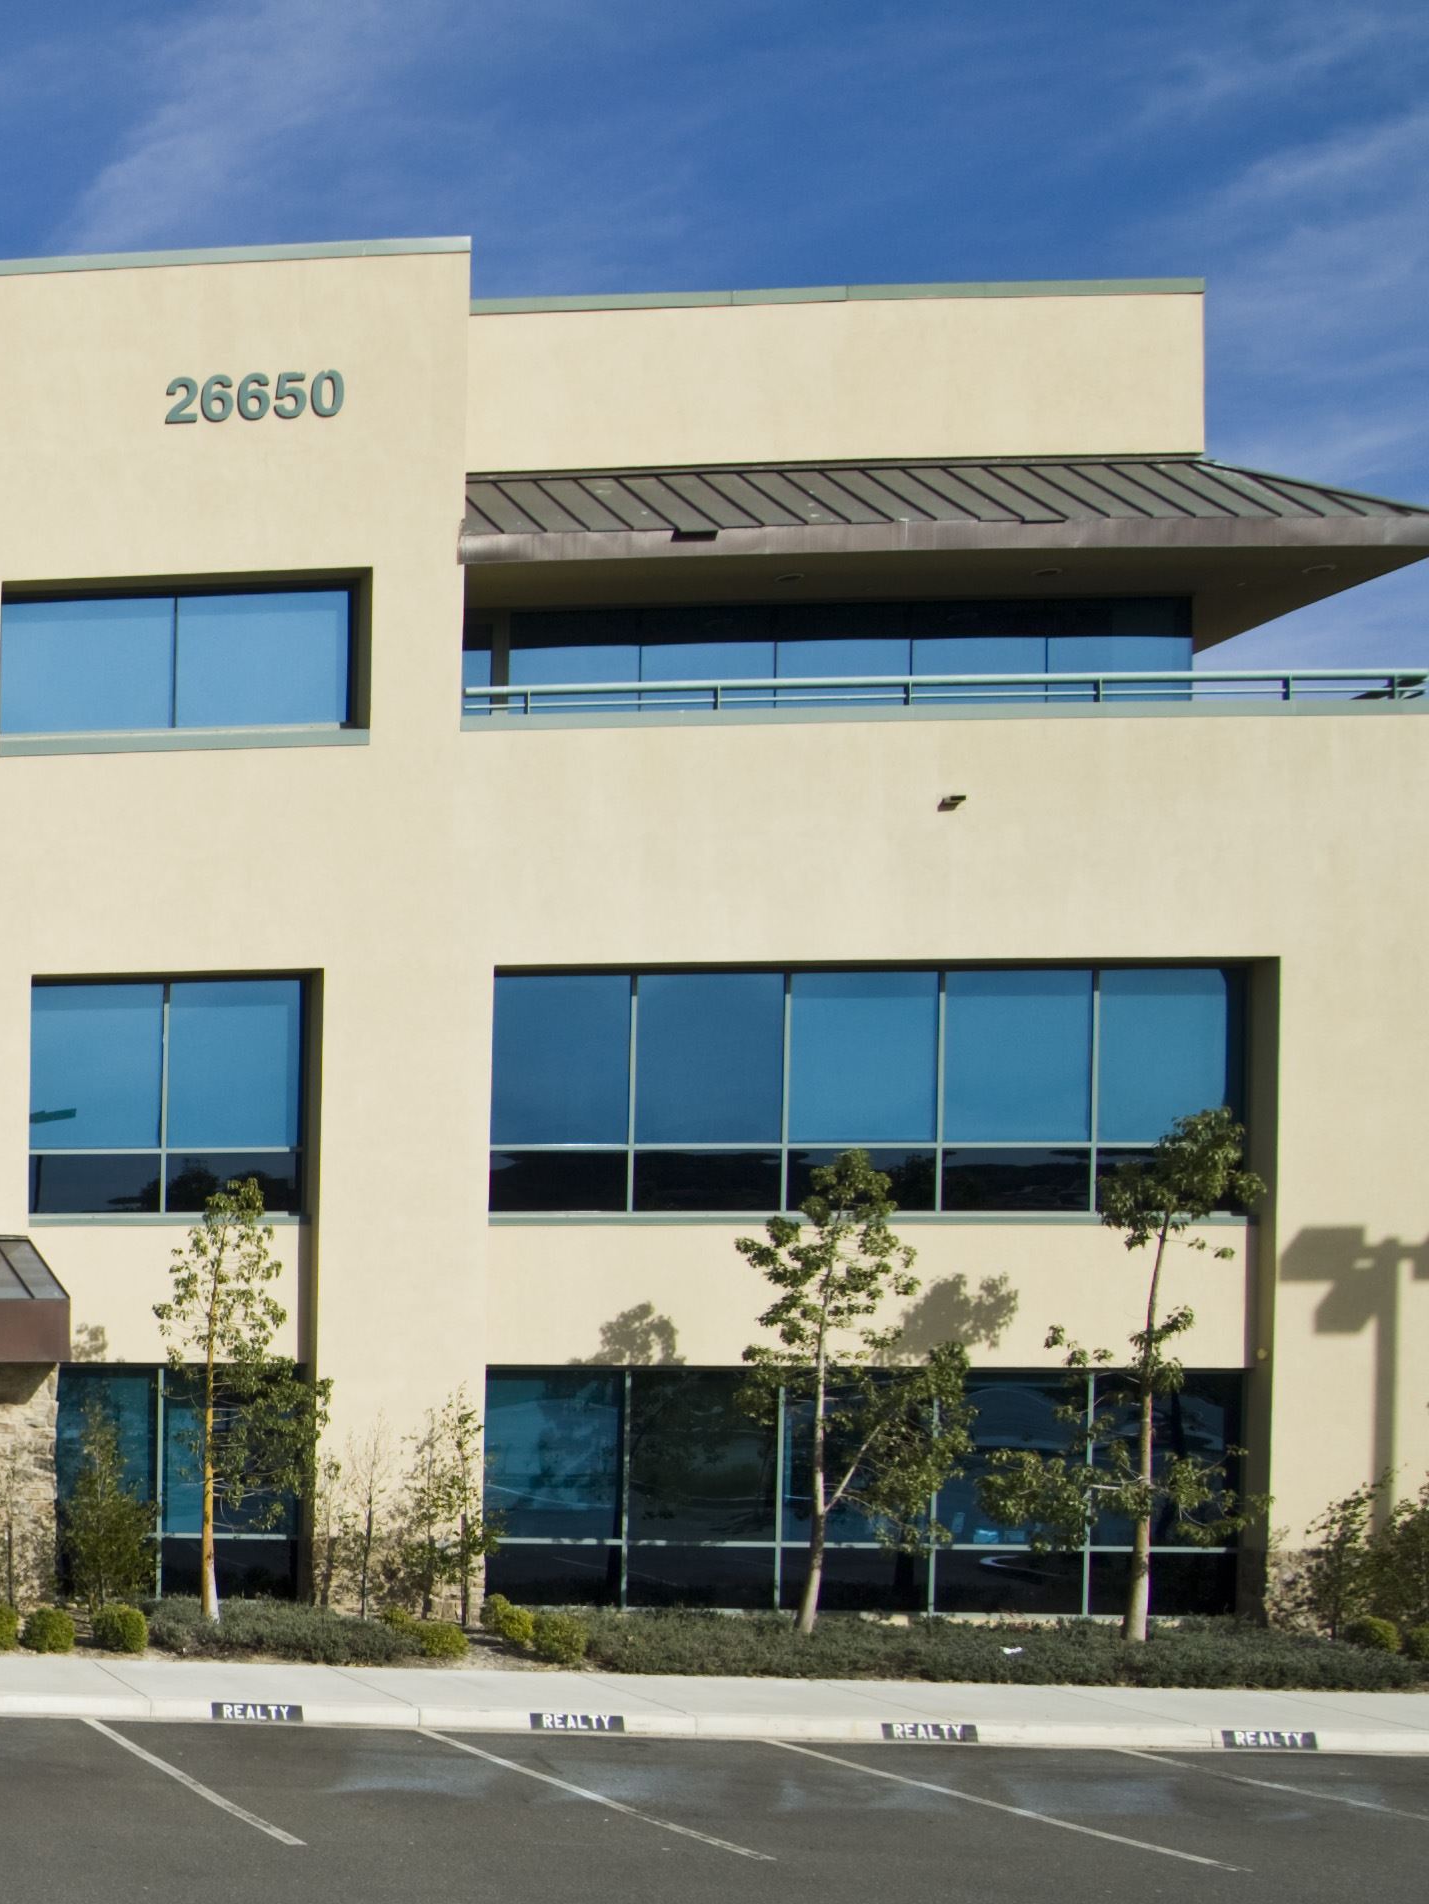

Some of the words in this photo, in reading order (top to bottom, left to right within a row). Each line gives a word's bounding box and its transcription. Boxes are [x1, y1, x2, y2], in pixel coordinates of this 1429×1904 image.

[164, 368, 345, 424] 26650
[222, 1703, 290, 1721] REALTY
[542, 1713, 611, 1730] REALTY
[892, 1723, 962, 1740] REALTY
[1233, 1731, 1303, 1748] REALTY
